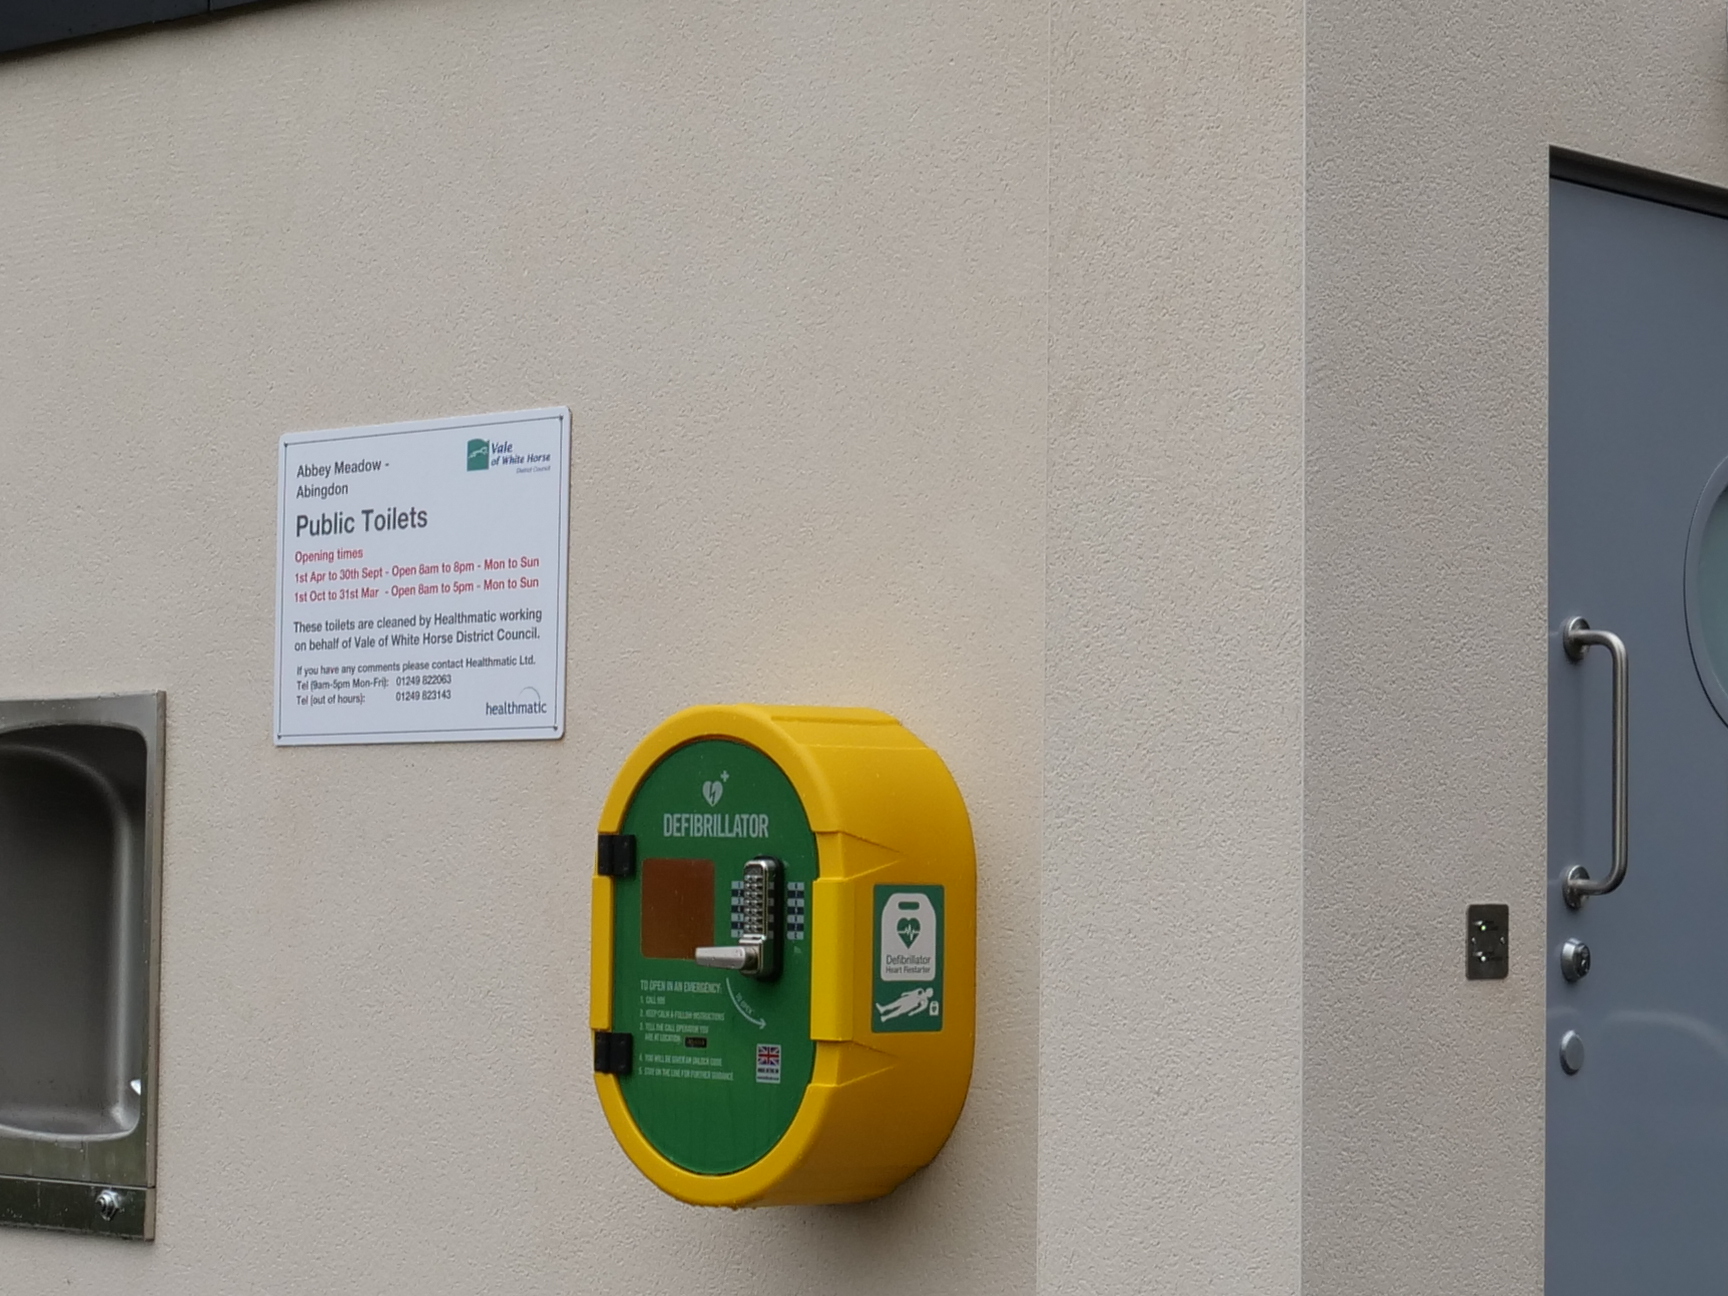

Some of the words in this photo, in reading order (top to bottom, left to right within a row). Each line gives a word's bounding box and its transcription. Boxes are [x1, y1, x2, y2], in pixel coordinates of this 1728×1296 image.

[491, 441, 513, 454] Vale
[296, 463, 331, 479] Abbey
[334, 458, 382, 475] Meadow
[490, 456, 501, 466] of
[502, 454, 525, 465] White
[526, 453, 551, 463] Horse
[296, 482, 349, 500] Abingdon
[296, 511, 355, 538] Public
[361, 506, 428, 532] Toilets
[295, 549, 334, 564] Opening
[337, 547, 363, 560] times
[295, 573, 308, 584] 1st
[310, 571, 326, 583] Apr
[328, 570, 337, 581] to
[339, 568, 359, 581] 30th
[361, 566, 383, 580] Sept
[391, 564, 417, 579] Open
[418, 563, 439, 575] 8am
[441, 562, 451, 573] to
[453, 560, 475, 574] 8pm
[484, 558, 505, 570] Mon
[508, 557, 518, 569] to
[520, 555, 540, 568] Sun
[294, 591, 308, 603] 1st
[309, 589, 326, 602] Oct
[328, 589, 337, 600] to
[339, 588, 359, 600] 31st
[361, 586, 379, 599] Mar
[390, 584, 416, 599] Open
[417, 583, 439, 595] 8am
[441, 582, 451, 593] to
[453, 580, 474, 594] 5pm
[483, 578, 505, 591] Mon
[508, 577, 517, 589] to
[520, 575, 540, 588] Sun
[293, 620, 323, 633] These
[325, 618, 356, 632] toilets
[358, 618, 375, 630] are
[376, 613, 417, 629] cleaned
[418, 613, 432, 629] by
[434, 609, 497, 625] Healthmatic
[499, 607, 543, 623] working
[294, 641, 307, 652] on
[309, 637, 339, 651] behalf
[341, 636, 352, 649] of
[354, 634, 376, 649] Vale
[378, 633, 389, 647] of
[390, 632, 420, 647] White
[422, 631, 454, 645] Horse
[456, 628, 494, 644] District
[496, 625, 541, 642] Council.
[296, 665, 303, 676] If
[304, 667, 319, 678] you
[320, 664, 340, 675] have
[341, 664, 356, 676] any
[357, 661, 401, 674] comments
[402, 660, 430, 673] please
[431, 657, 464, 670] contact
[465, 654, 518, 669] Healthmatic
[519, 653, 536, 666] Ltd.
[296, 680, 309, 691] Tel
[395, 675, 421, 687] 01249
[296, 694, 309, 706] Tel
[327, 693, 336, 705] of
[395, 690, 421, 702] 01249
[485, 701, 548, 716] healthmatic
[663, 812, 770, 838] DEFIBRILLATOR
[885, 953, 932, 966] Defibrillator
[640, 979, 649, 991] TO
[649, 979, 666, 992] OPEN
[666, 980, 674, 992] IN
[674, 980, 683, 993] AN
